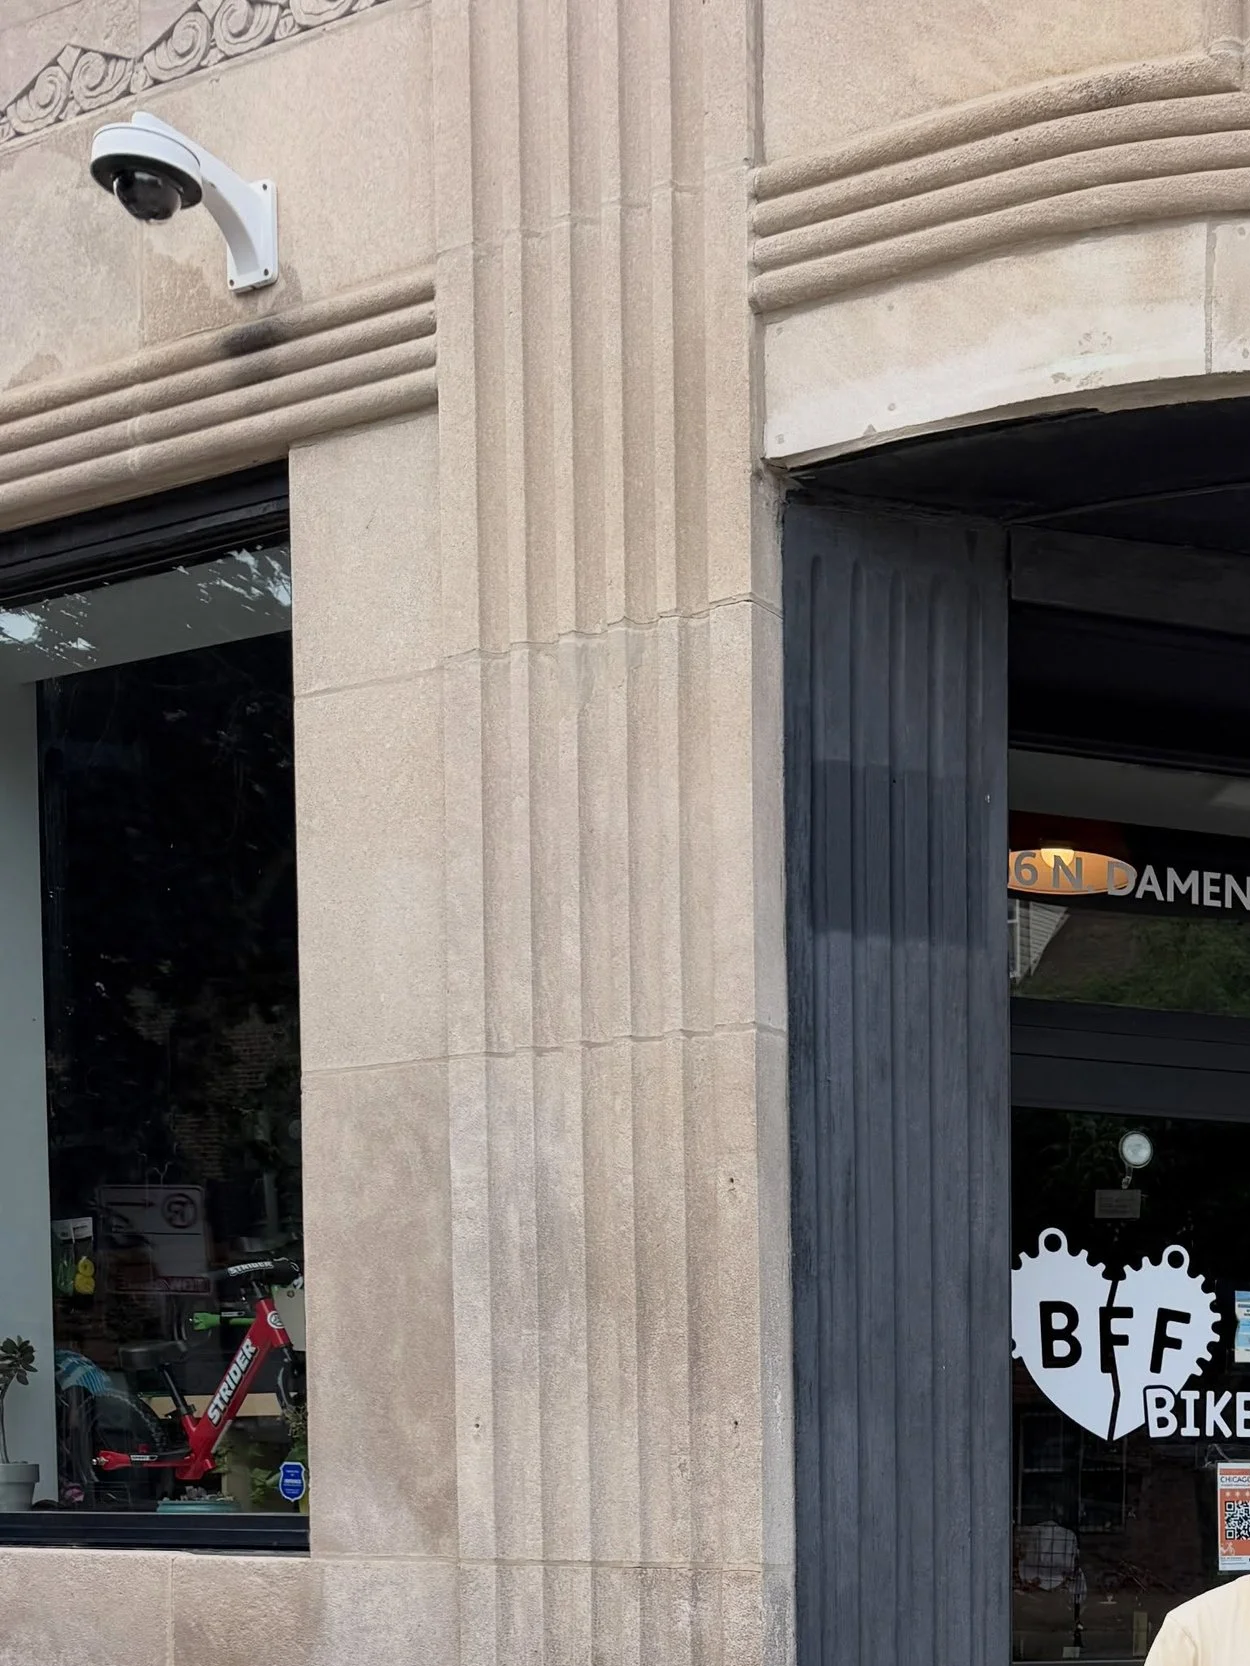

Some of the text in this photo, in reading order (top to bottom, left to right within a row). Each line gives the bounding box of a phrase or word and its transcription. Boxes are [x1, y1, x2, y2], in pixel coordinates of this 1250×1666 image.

[227, 1261, 274, 1276] STRIDER
[1039, 1300, 1191, 1374] BFF
[207, 1337, 260, 1427] STRIDER
